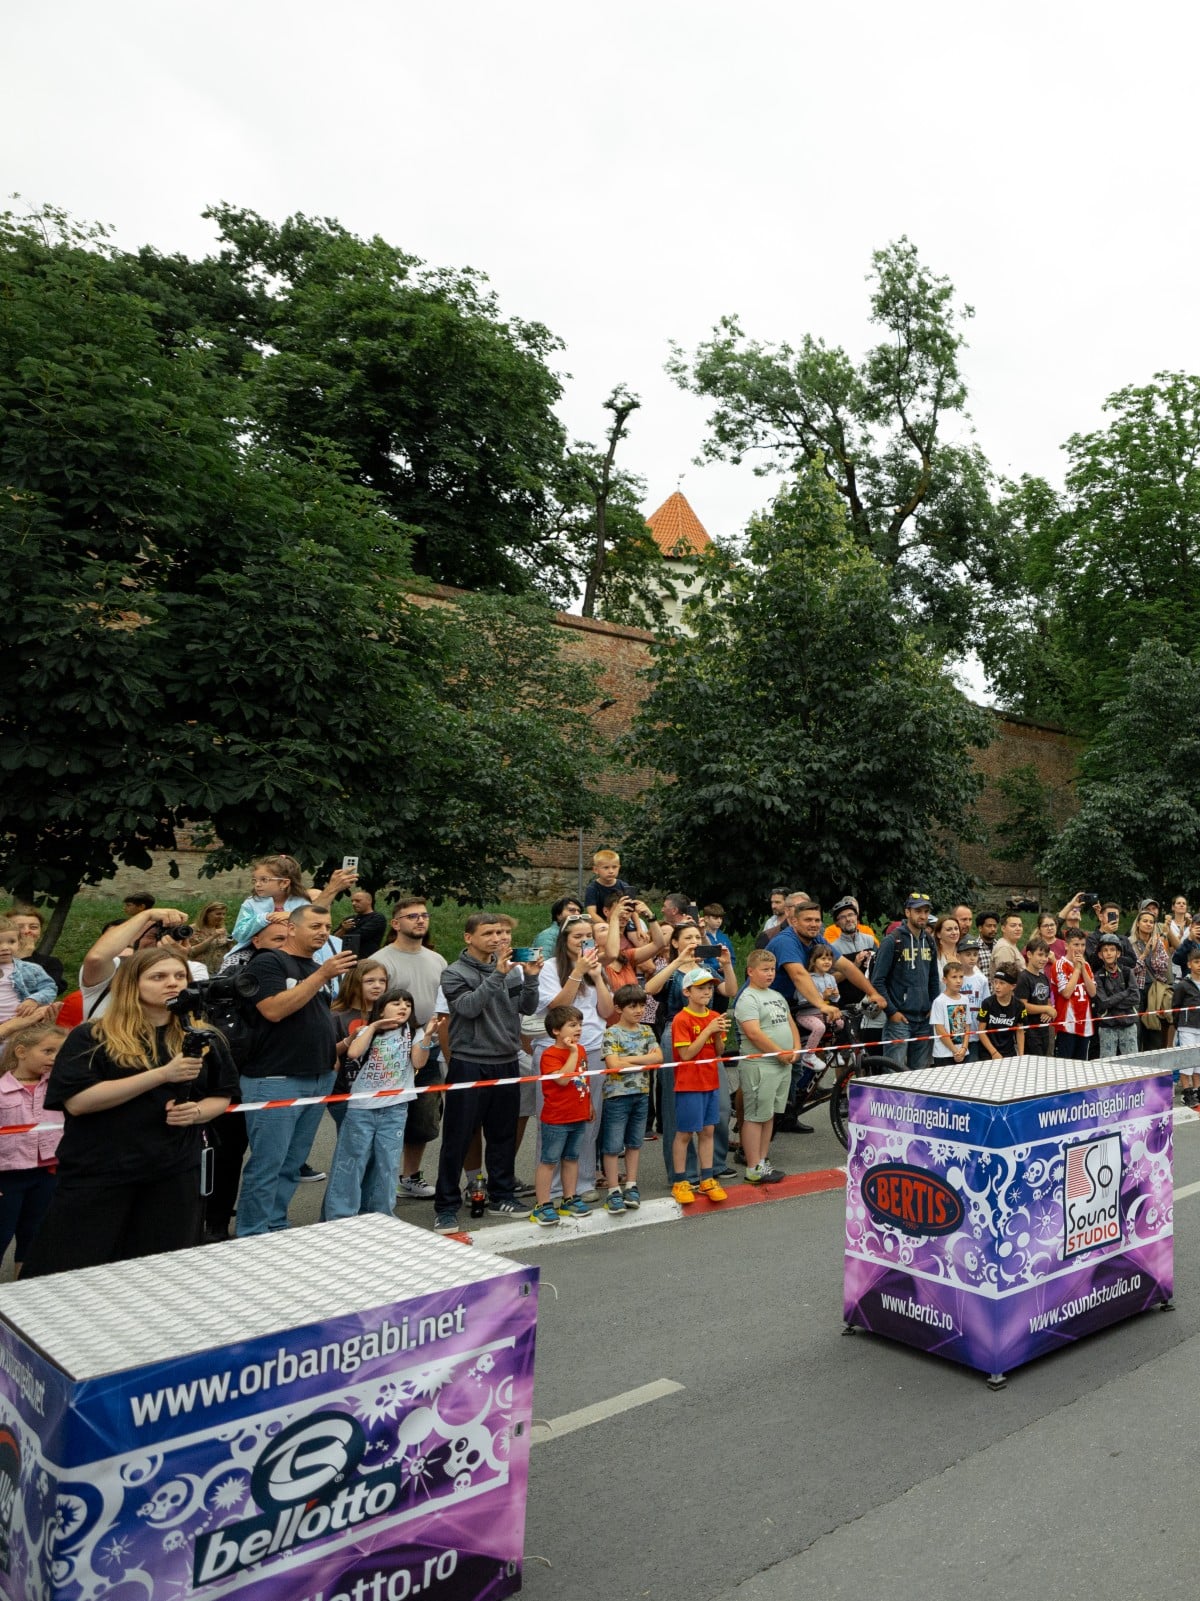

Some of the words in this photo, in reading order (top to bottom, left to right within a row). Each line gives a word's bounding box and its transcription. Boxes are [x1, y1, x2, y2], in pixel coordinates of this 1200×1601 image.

[870, 1100, 971, 1133] www.orbangabi.net
[1038, 1090, 1145, 1128] www.orbangabi.net
[876, 1177, 947, 1224] BERTIS
[1068, 1190, 1117, 1234] Sound
[1067, 1221, 1118, 1252] STUDIO
[881, 1292, 953, 1331] www.bertis.ro
[1029, 1273, 1141, 1334] www.soundstudio.ro
[131, 1304, 466, 1427] www.orbangabi.net
[200, 1481, 396, 1582] bellotto
